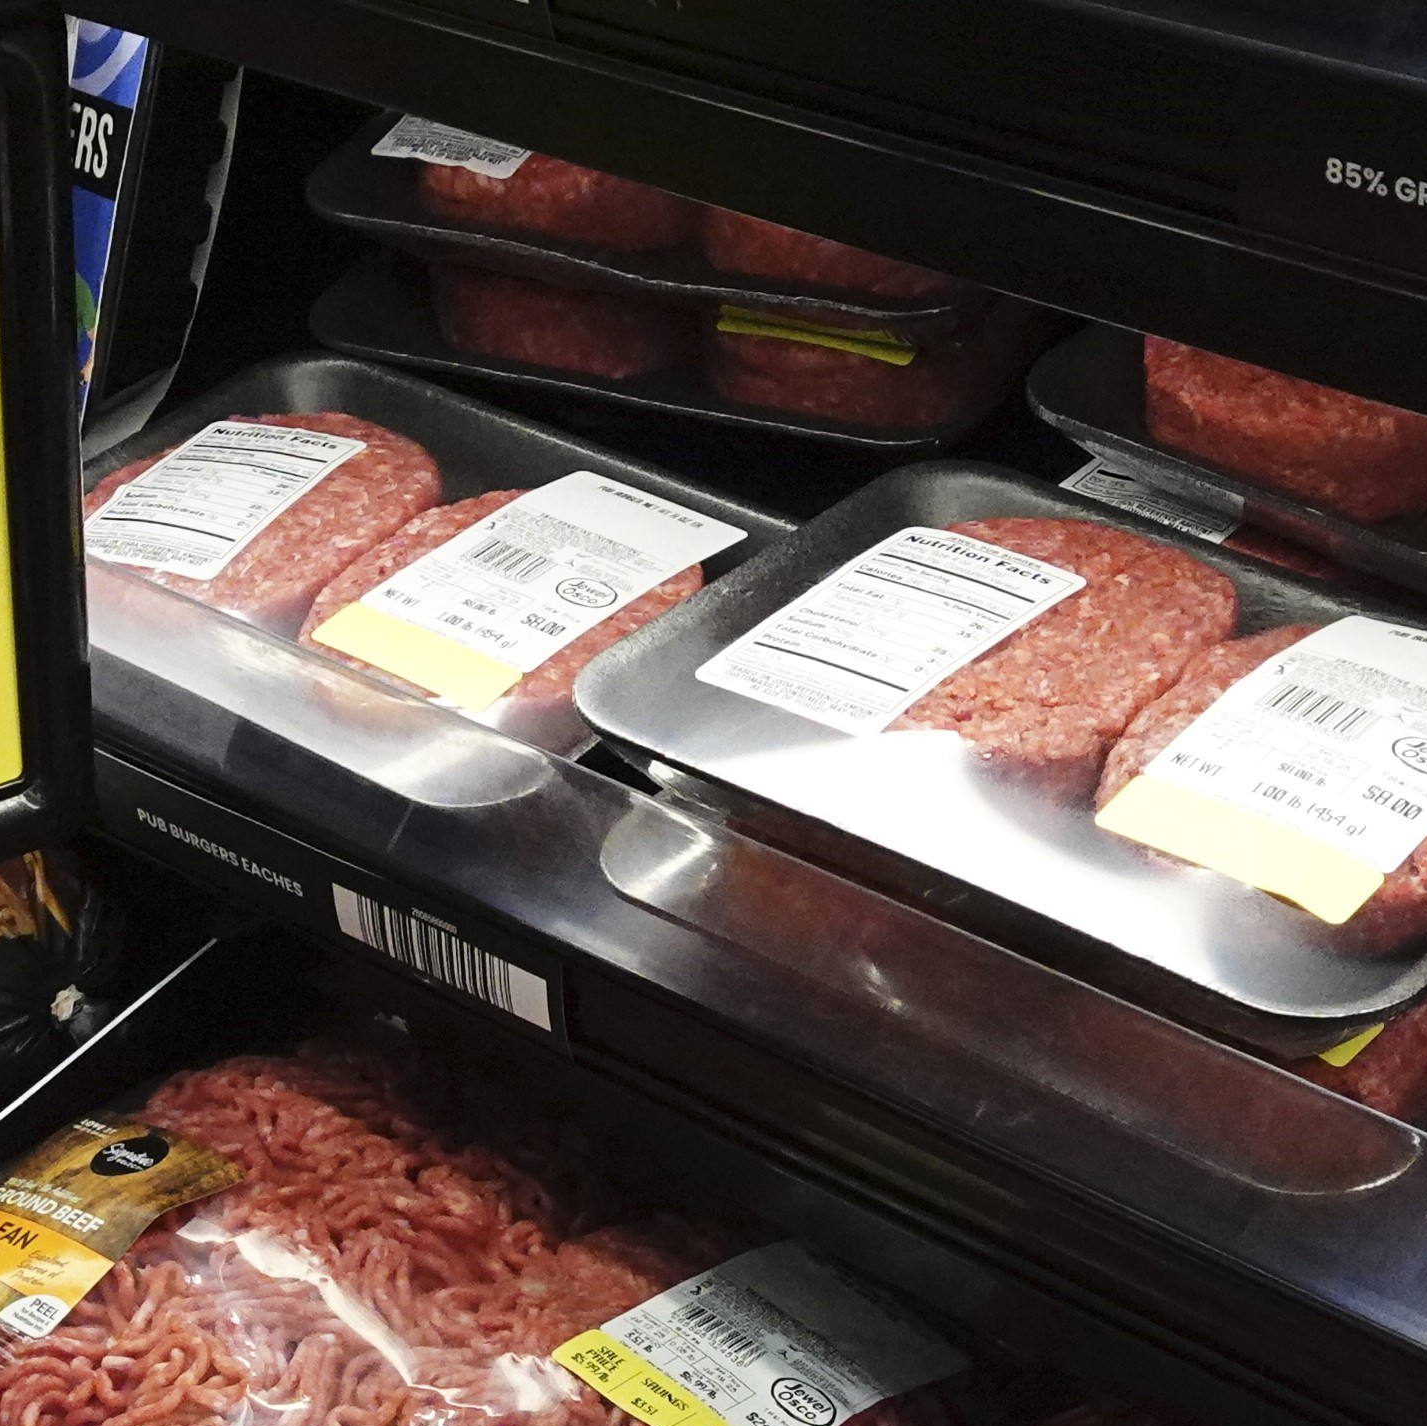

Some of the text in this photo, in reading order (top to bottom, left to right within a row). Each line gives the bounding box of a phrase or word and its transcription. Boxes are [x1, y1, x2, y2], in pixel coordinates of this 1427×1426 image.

[1325, 157, 1389, 199] 85%
[904, 534, 1052, 588] Nutrition Facts
[137, 808, 303, 897] PUB BURGERS EACHES
[51, 1205, 105, 1233] BEEF
[631, 1397, 658, 1416] $3.51
[641, 1377, 690, 1411] SAVINGS
